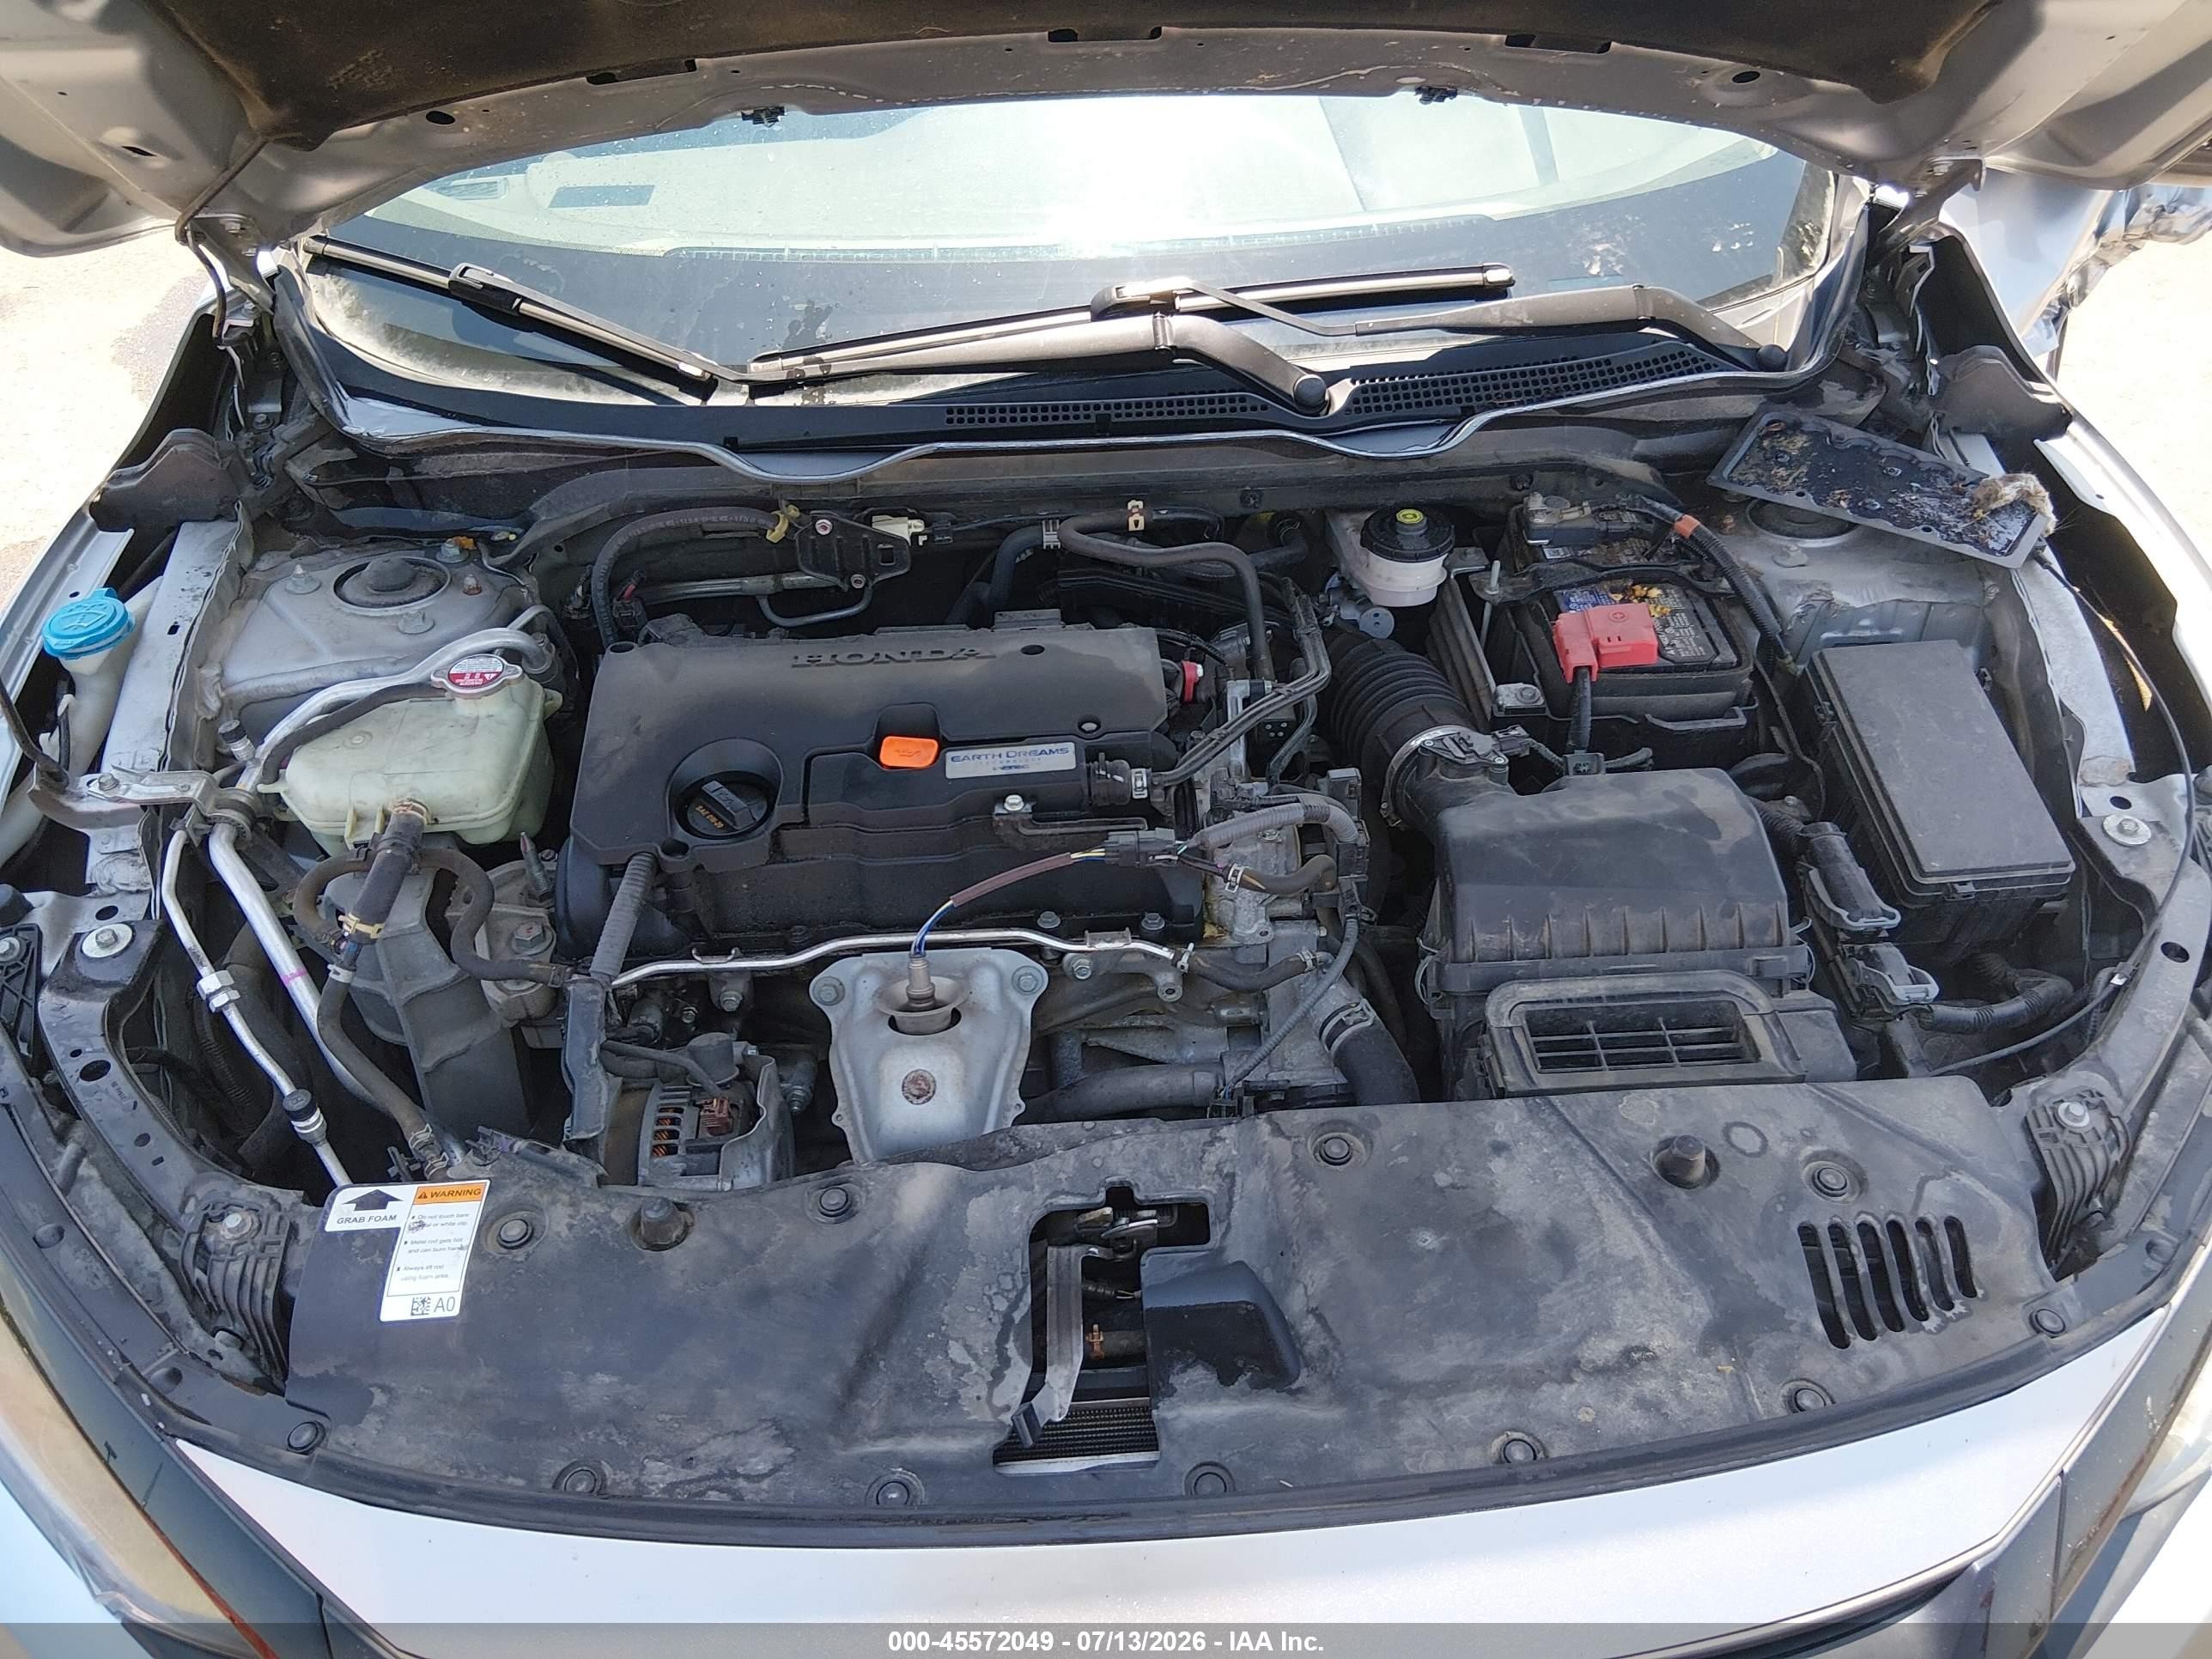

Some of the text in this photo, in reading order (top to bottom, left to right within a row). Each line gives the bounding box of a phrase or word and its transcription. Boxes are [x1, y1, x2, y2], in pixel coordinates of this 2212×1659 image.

[792, 647, 997, 669] HONDA
[951, 747, 1070, 763] EARTH DREAMS
[430, 1188, 482, 1199] WARNING
[337, 1214, 398, 1224] GRAB FOAM
[433, 1296, 456, 1312] A0
